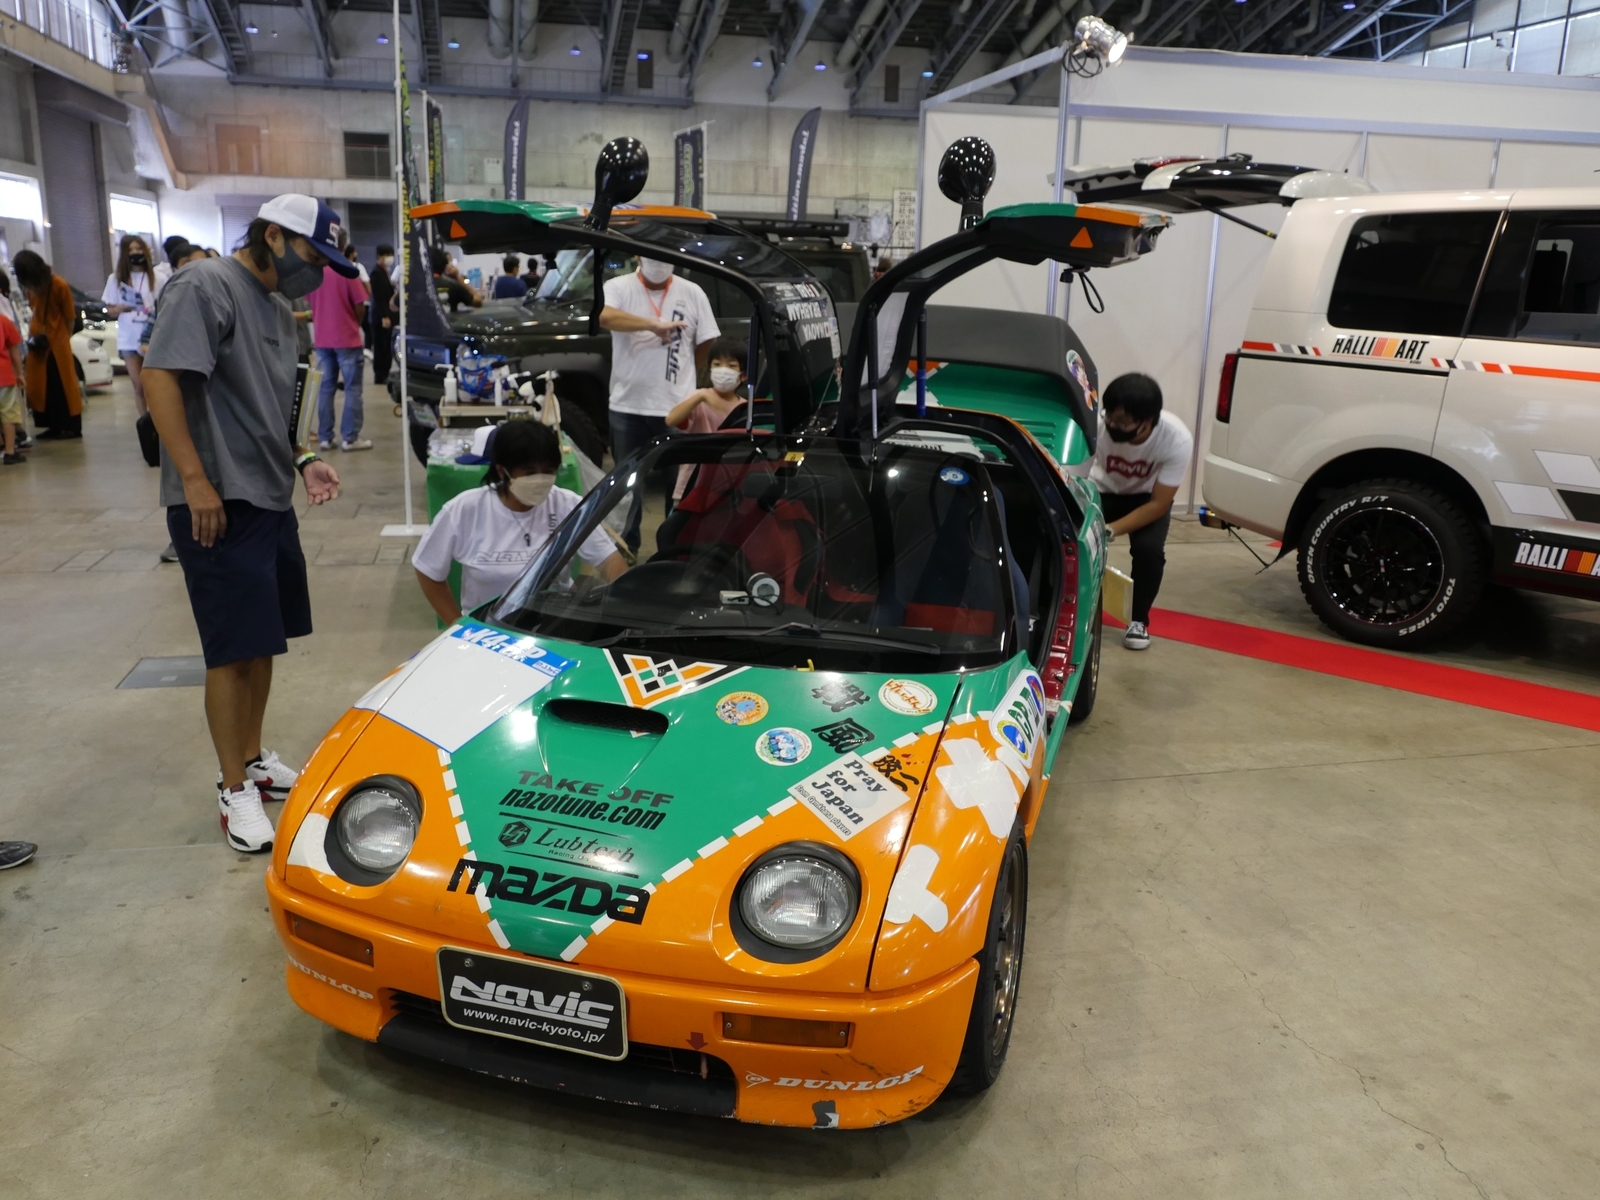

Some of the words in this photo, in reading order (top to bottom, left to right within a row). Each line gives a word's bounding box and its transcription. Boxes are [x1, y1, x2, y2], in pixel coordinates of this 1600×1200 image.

[1394, 339, 1430, 360] ART
[1306, 546, 1316, 584] OPEN
[1311, 499, 1357, 546] COUNTRY
[1361, 495, 1389, 503] R/T
[1514, 541, 1569, 570] RALLI
[1436, 577, 1456, 613] TOYO
[1399, 612, 1437, 636] TIRES
[518, 770, 604, 797] TAKE
[607, 786, 675, 808] OFF
[826, 770, 857, 792] for
[843, 759, 887, 793] Pray
[498, 788, 667, 831] nazotune.com
[794, 784, 811, 798] From
[807, 795, 833, 822] Gymkhana
[830, 817, 852, 836] players
[811, 781, 864, 825] Japan
[532, 827, 635, 863] Lubtech
[548, 849, 574, 860] Racing
[287, 953, 374, 1000] DUNLOP
[463, 1008, 606, 1043] www.navic-kyoto.jp/
[773, 1065, 924, 1091] DUNLOP
